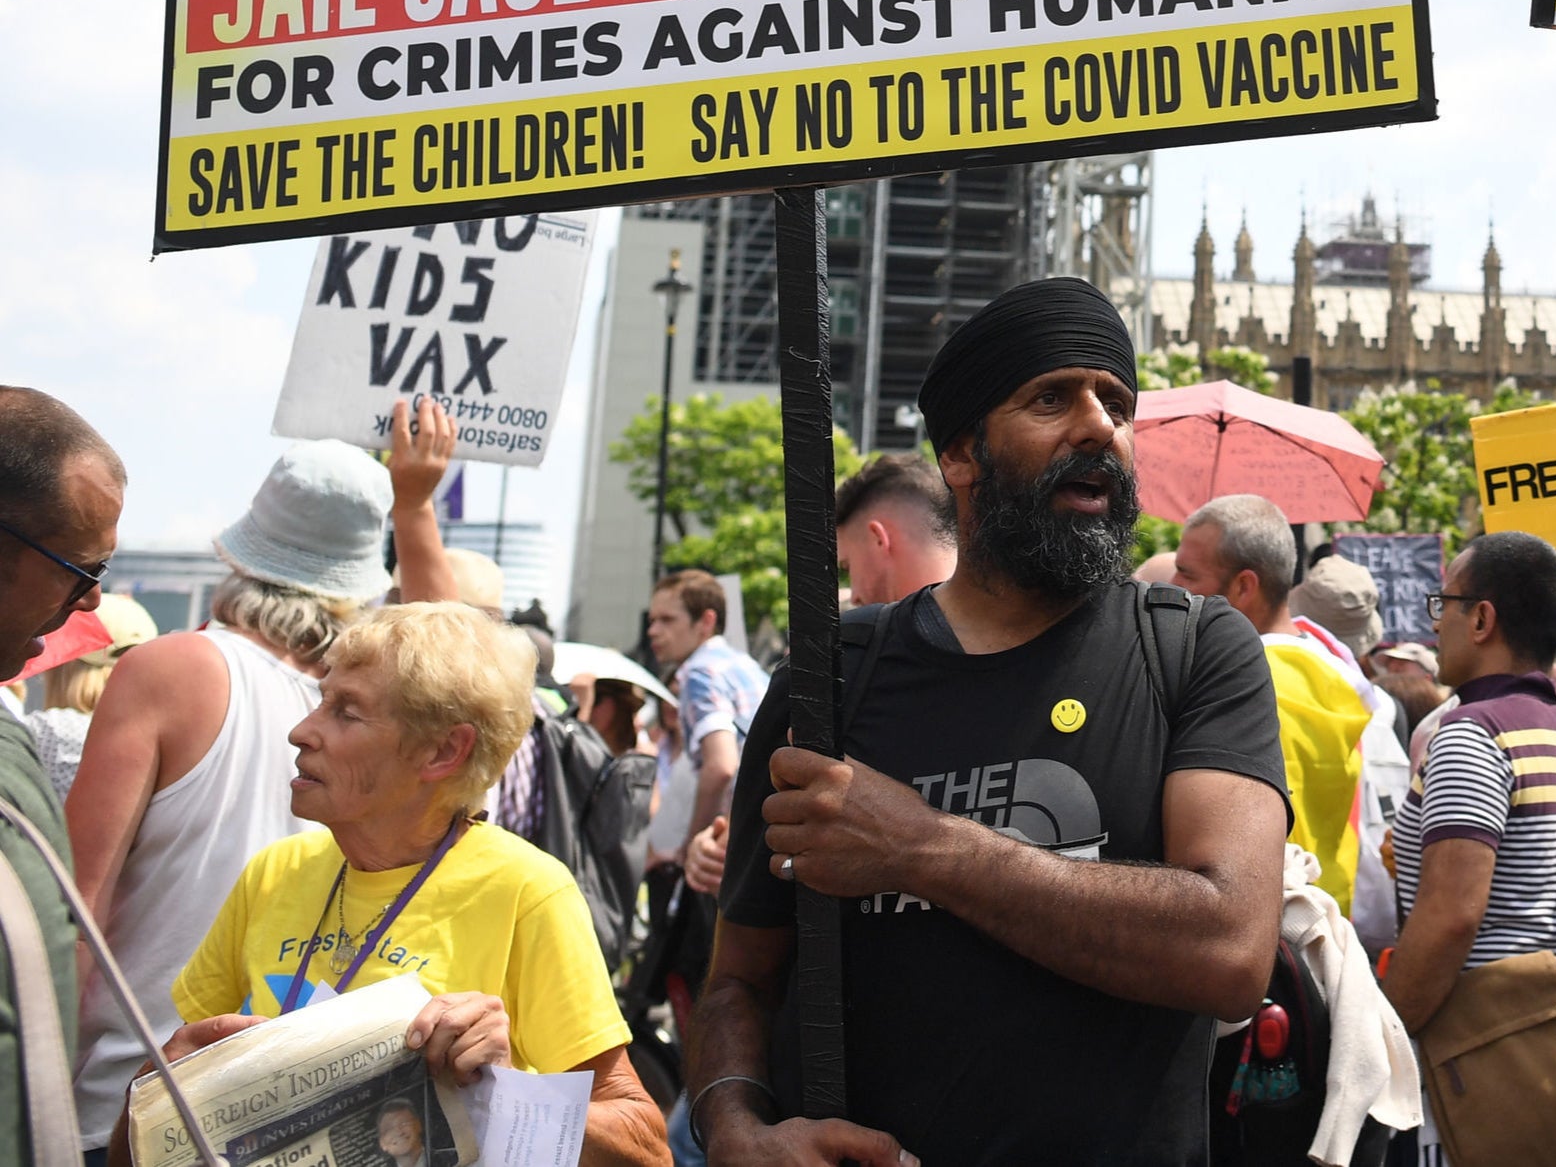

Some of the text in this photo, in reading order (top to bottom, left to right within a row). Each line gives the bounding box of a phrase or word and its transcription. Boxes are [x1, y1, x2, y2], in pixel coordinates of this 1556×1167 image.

[196, 54, 334, 119] FOR
[357, 21, 622, 100] CRIMES
[188, 22, 1397, 216] SAVE THE CHILDREN! SAY NO TO THE COVID VACCINE
[316, 236, 495, 322] KIDS
[369, 323, 507, 395] VAX
[456, 399, 494, 422] 444
[497, 405, 548, 430] 0800
[912, 762, 1013, 812] THE
[279, 927, 350, 961] Fresh
[164, 1086, 280, 1153] SOEREIGN
